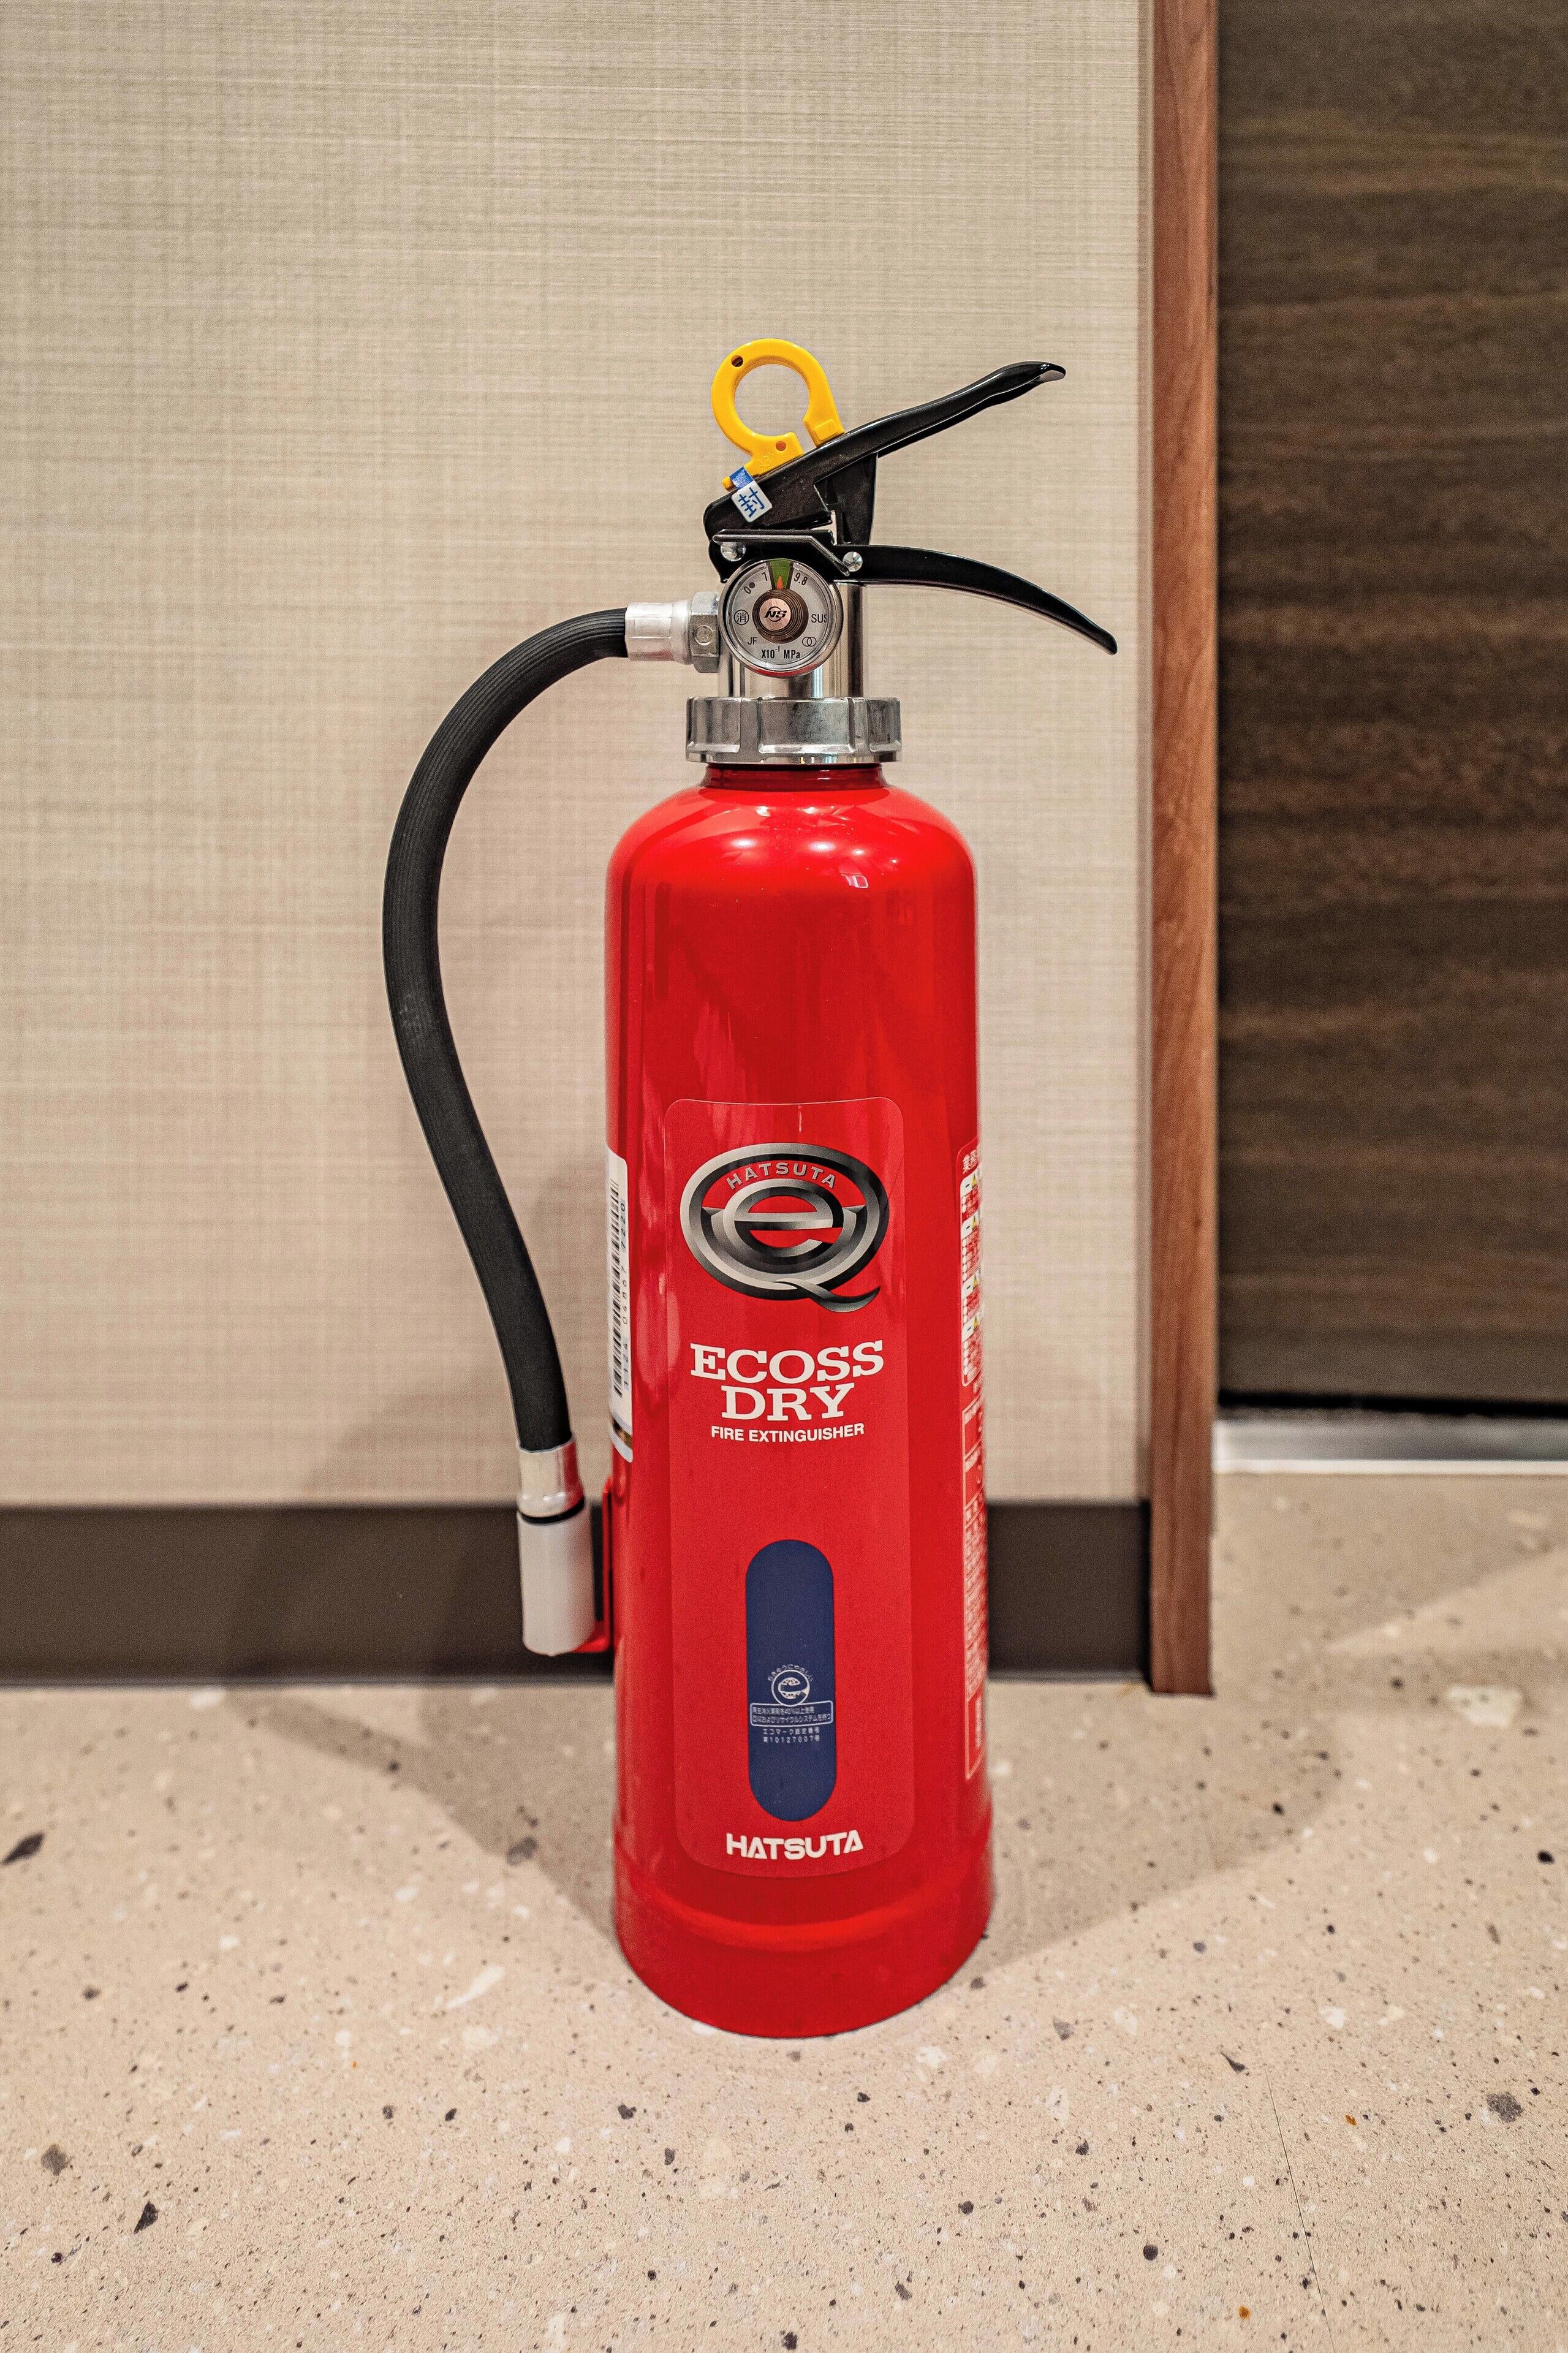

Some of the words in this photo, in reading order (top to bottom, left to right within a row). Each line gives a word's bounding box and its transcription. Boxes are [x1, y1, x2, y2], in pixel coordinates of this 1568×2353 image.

[738, 487, 765, 518] 封
[793, 572, 808, 586] 9.8
[736, 612, 748, 623] 消
[811, 613, 827, 623] SUS
[747, 637, 758, 645] JF
[783, 650, 800, 659] MPa
[725, 1162, 836, 1189] HATSUTA
[690, 1339, 884, 1384] ECOSS
[721, 1382, 855, 1422] DRY
[711, 1425, 744, 1441] FIRE
[748, 1423, 865, 1443] EXTINGUISHER
[726, 1830, 864, 1860] HATSUTA
